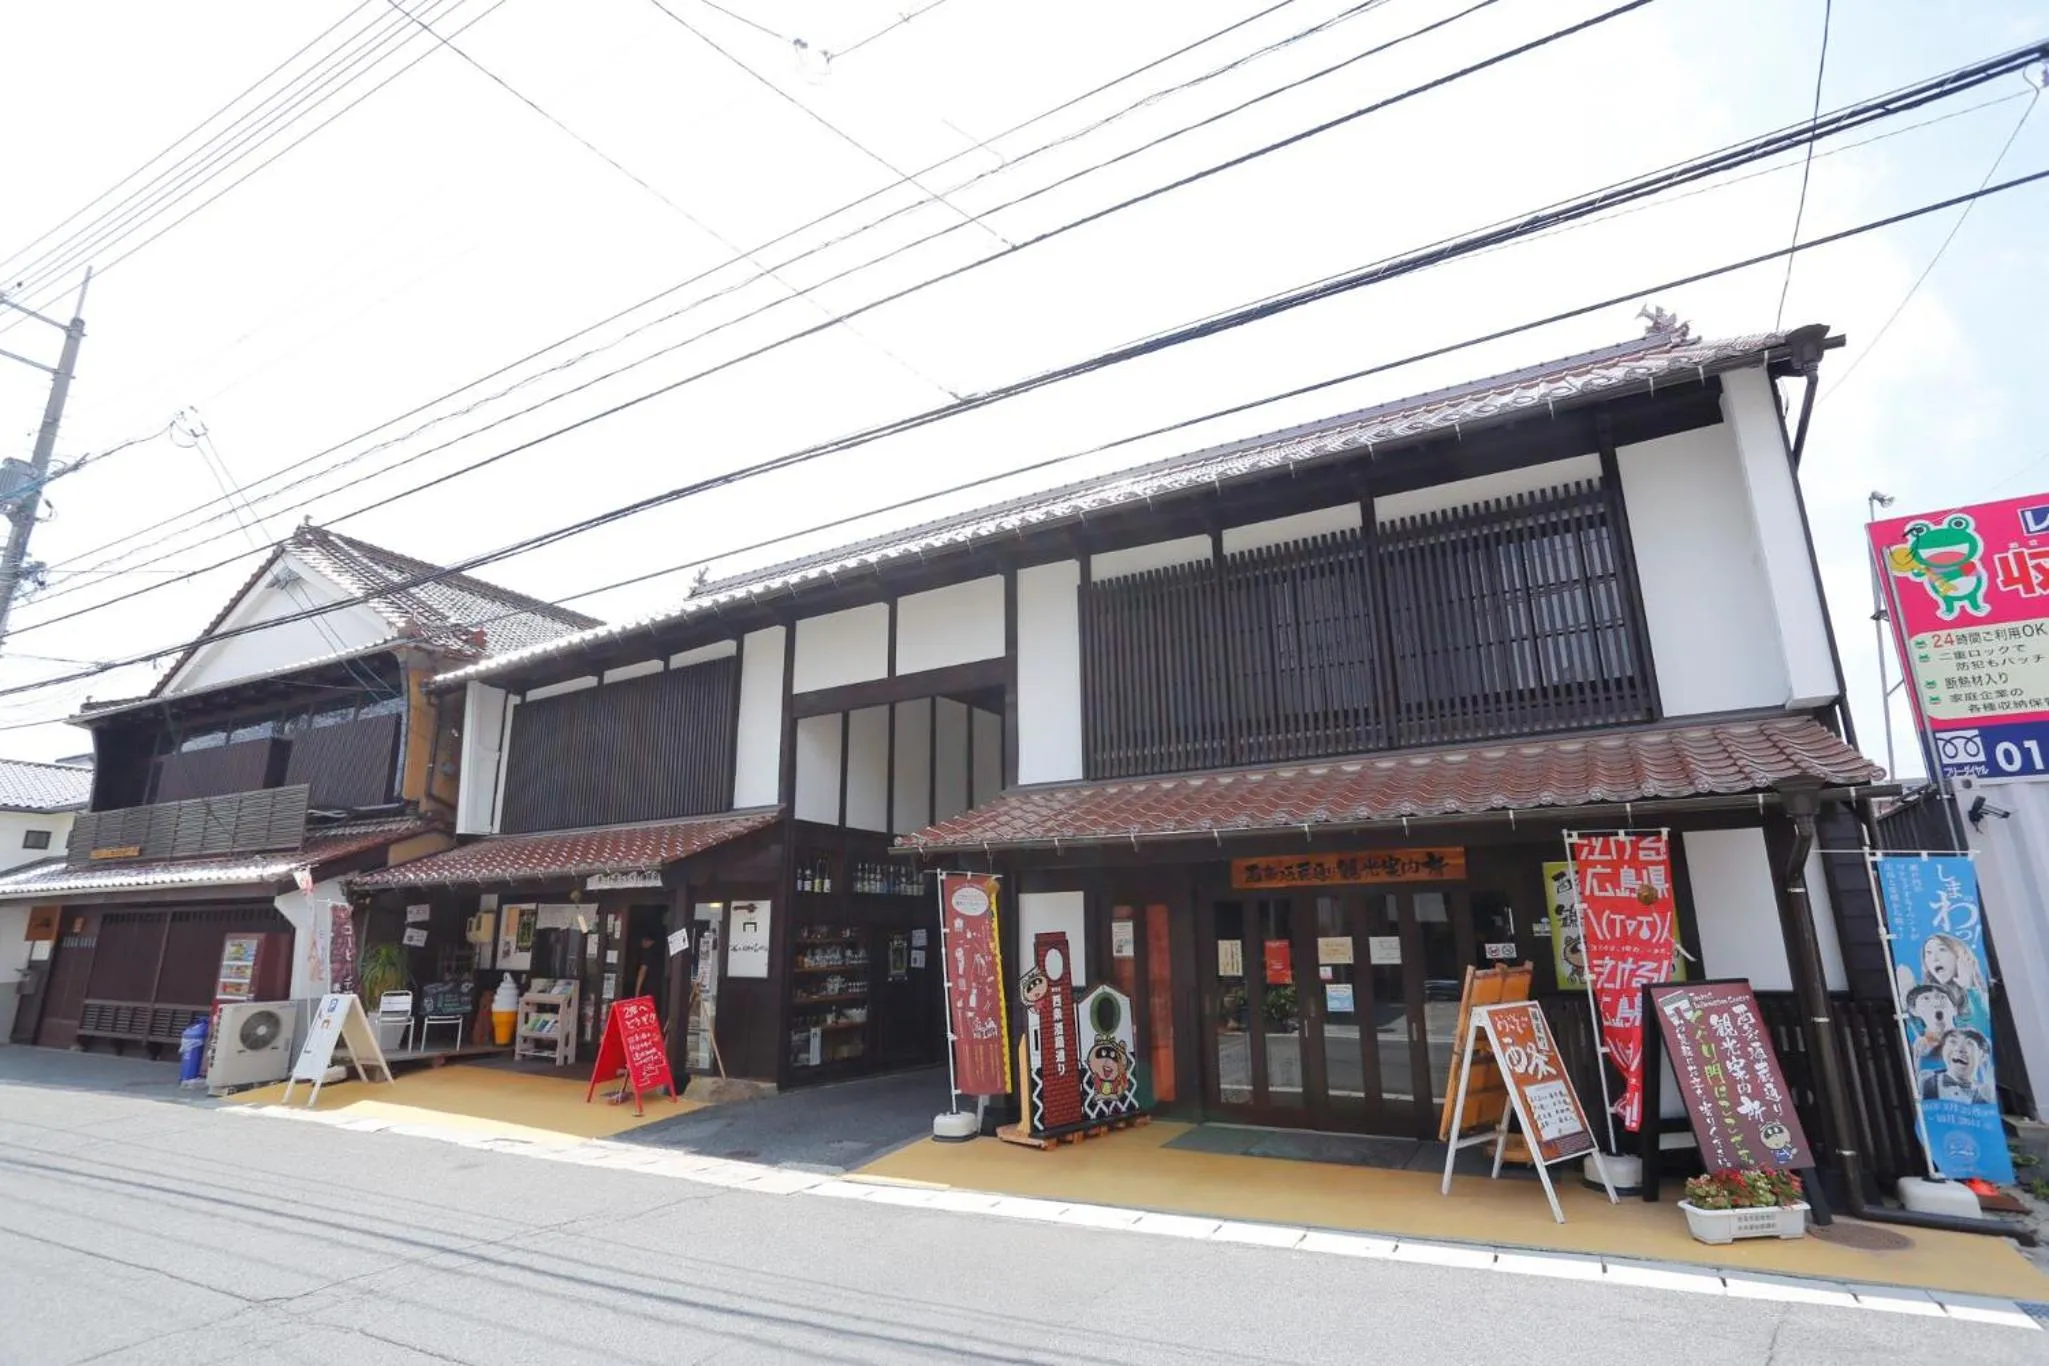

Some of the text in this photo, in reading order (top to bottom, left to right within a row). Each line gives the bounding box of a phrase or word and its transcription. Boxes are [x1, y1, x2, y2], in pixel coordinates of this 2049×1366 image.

[1931, 622, 2048, 649] 24時間ご利用OK
[1939, 643, 2028, 661] 二重ロックで
[1944, 671, 2009, 690] 断熱材入り
[1950, 687, 2024, 703] 家庭企業の
[1943, 764, 1990, 778] フリーダイヤル
[1584, 865, 1670, 898] 広島県
[1709, 1012, 1768, 1123] 観光案内所
